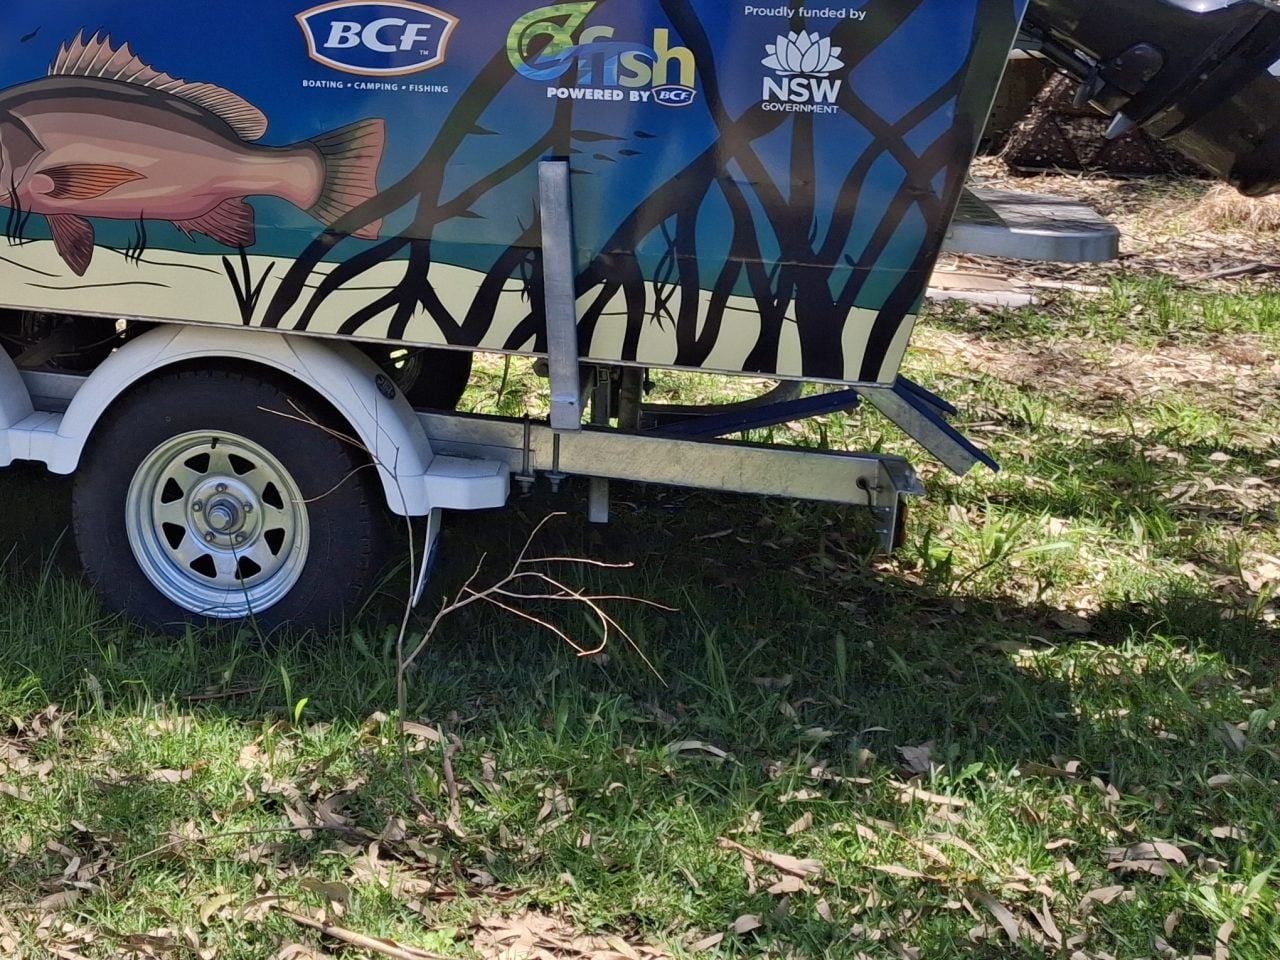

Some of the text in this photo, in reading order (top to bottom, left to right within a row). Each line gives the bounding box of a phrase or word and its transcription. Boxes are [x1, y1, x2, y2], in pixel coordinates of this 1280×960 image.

[744, 5, 867, 21] Proudly funded by
[323, 17, 432, 53] BCF
[302, 79, 449, 93] BOATING CAMPING FISHING
[762, 76, 842, 103] NSW
[546, 87, 651, 103] POWERED BY
[658, 89, 689, 101] BCF
[761, 102, 840, 114] GOVERNMENT
